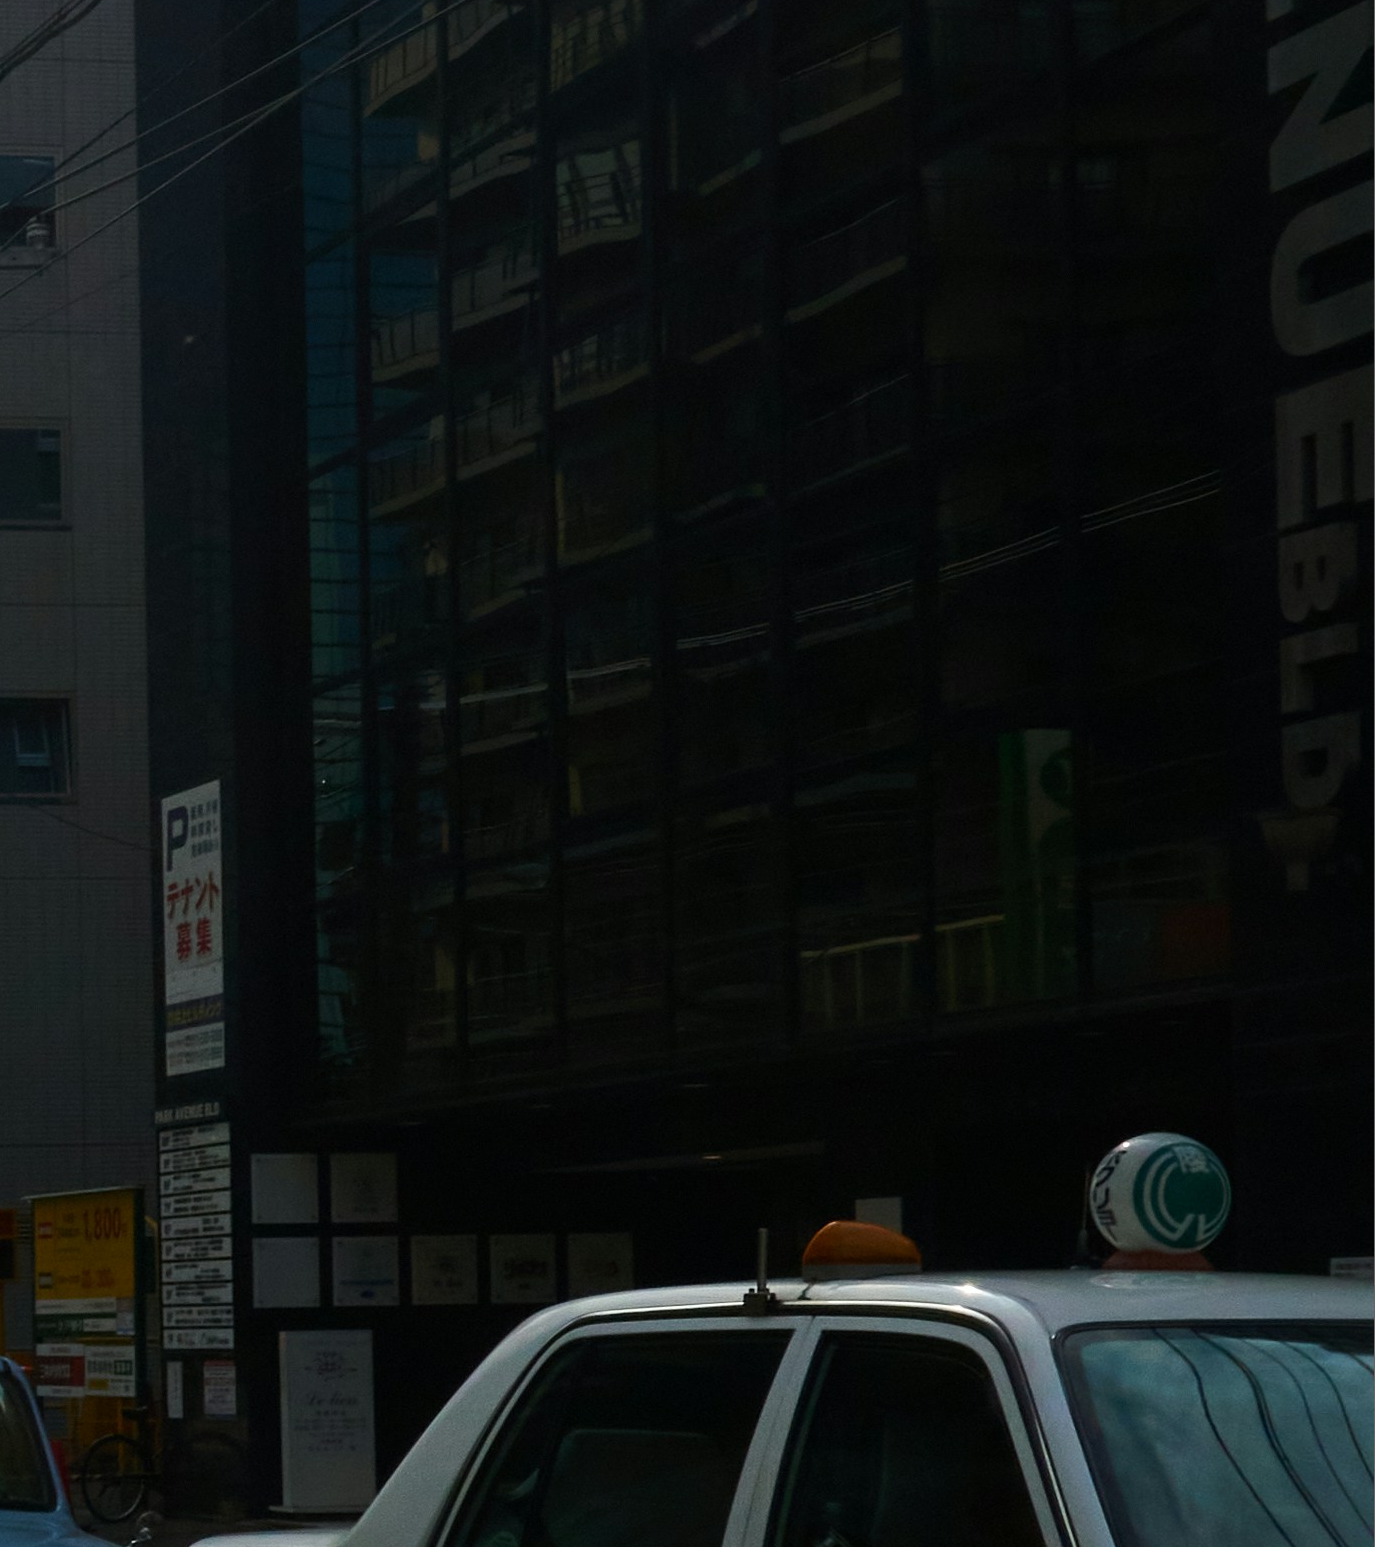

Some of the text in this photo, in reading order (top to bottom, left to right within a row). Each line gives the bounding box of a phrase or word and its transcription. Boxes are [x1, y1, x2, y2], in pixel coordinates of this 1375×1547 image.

[1276, 521, 1359, 807] BLD
[167, 806, 188, 872] P
[167, 871, 219, 919] テナント
[177, 916, 212, 963] 募集
